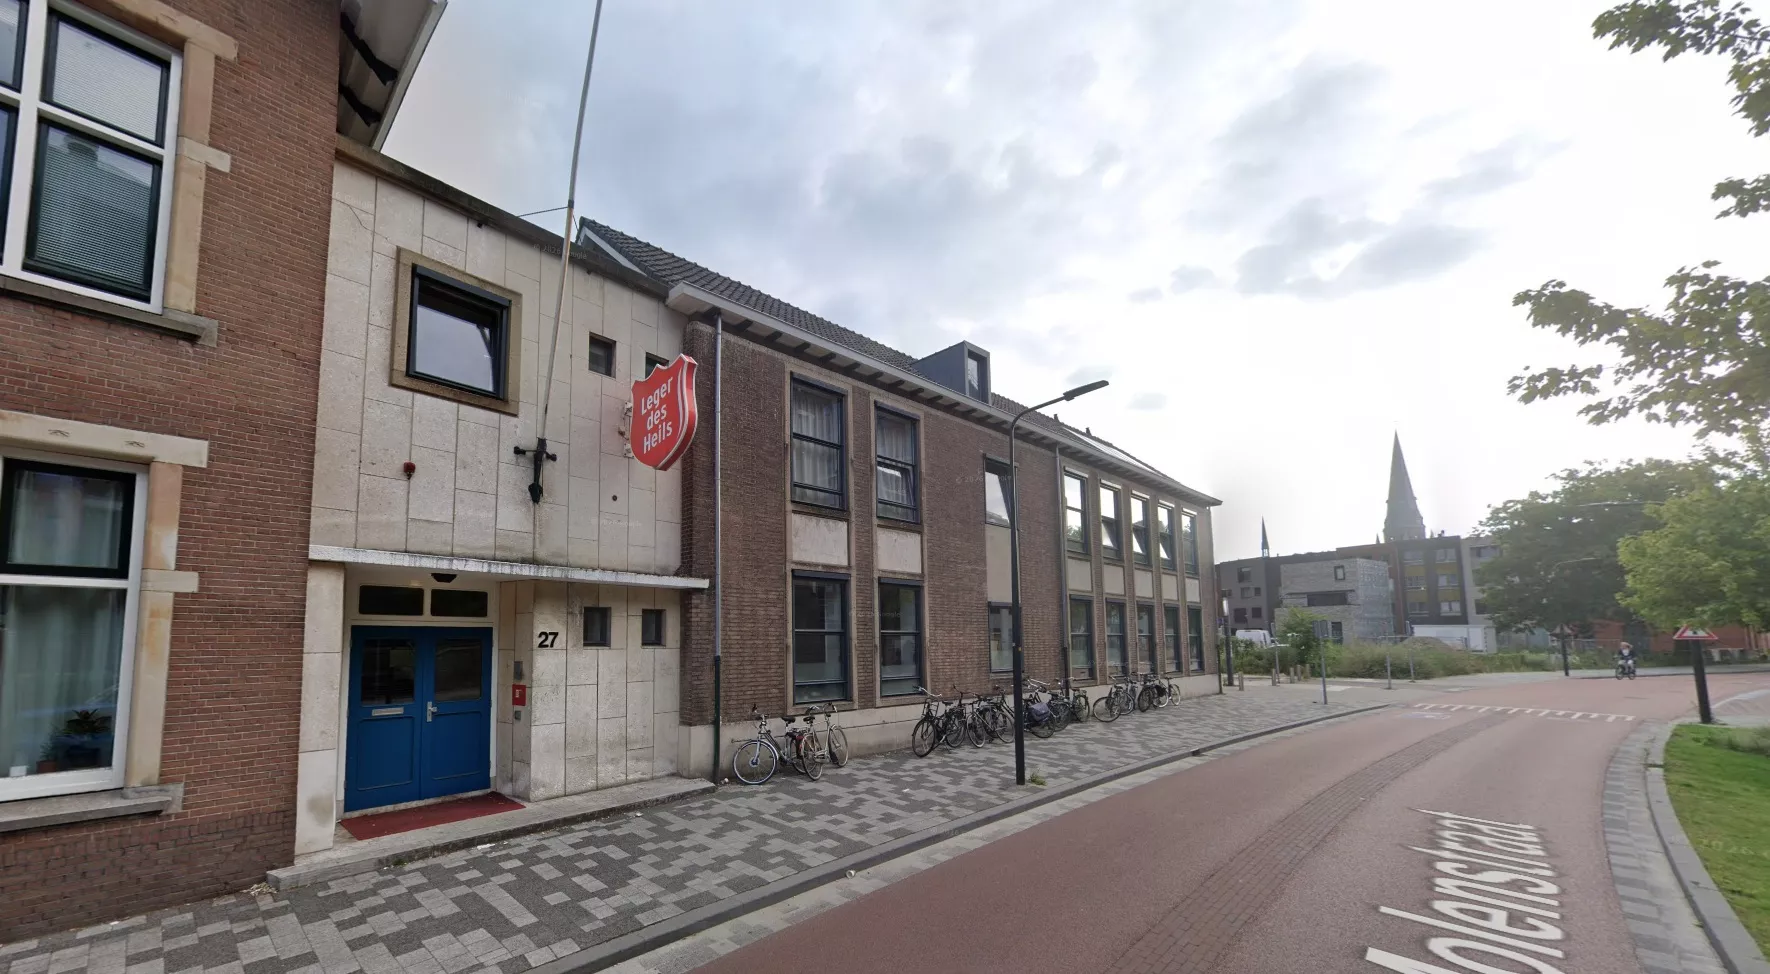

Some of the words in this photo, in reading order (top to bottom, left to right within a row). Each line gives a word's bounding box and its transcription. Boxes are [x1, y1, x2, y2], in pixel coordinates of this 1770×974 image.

[641, 376, 673, 415] Leger
[646, 404, 667, 431] des
[643, 421, 673, 454] Heils
[537, 631, 559, 649] 27
[1365, 807, 1565, 974] olenstraat
